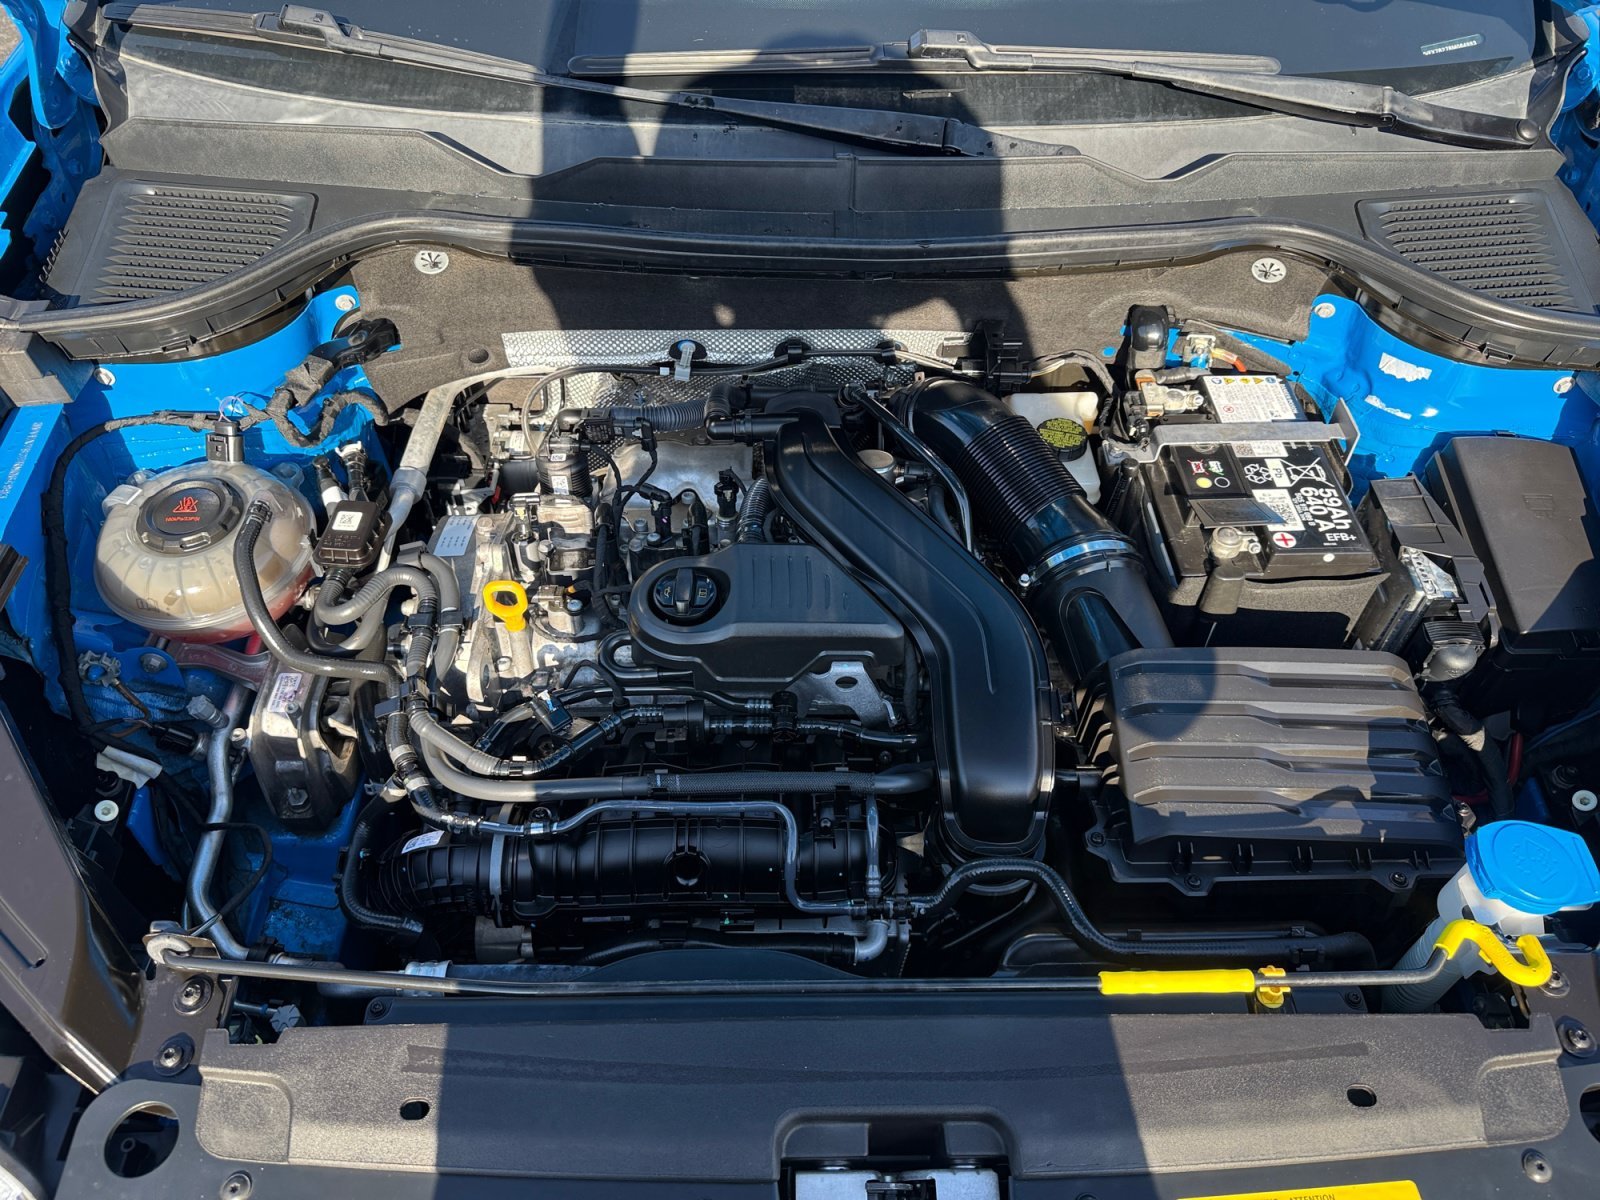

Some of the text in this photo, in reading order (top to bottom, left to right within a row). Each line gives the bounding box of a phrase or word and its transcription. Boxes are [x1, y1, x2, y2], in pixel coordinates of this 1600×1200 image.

[1272, 468, 1282, 478] Pb
[1300, 487, 1329, 515] 640
[1319, 488, 1352, 529] 59Ah
[1314, 519, 1336, 532] A
[1325, 532, 1357, 541] EFB+
